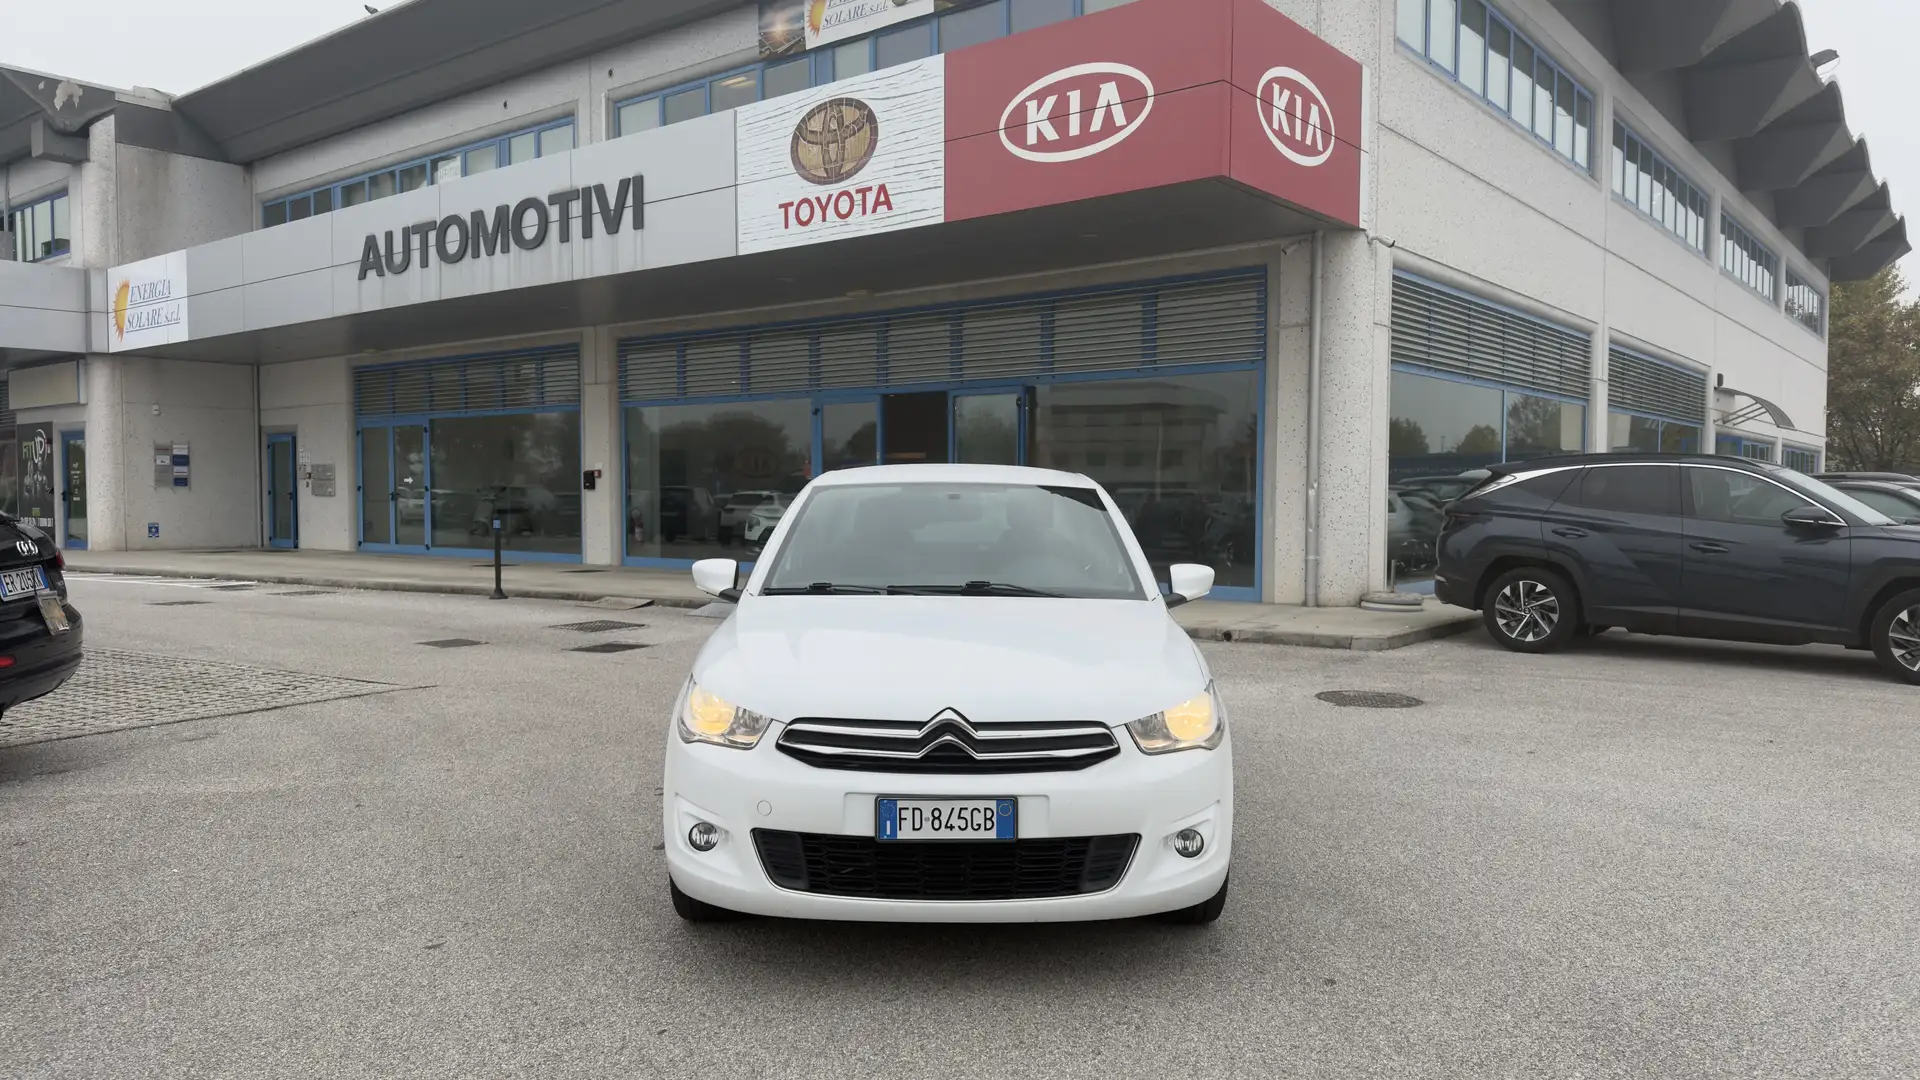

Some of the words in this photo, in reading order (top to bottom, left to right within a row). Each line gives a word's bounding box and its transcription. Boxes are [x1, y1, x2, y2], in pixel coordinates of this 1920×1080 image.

[822, 3, 868, 28] SOLARE
[1025, 80, 1128, 146] KIA
[1272, 82, 1324, 152] KIA
[358, 174, 644, 280] AUTOMOTIVI
[778, 183, 894, 230] TOYOTA
[130, 279, 171, 303] ENERGIA
[127, 307, 164, 330] SOLARE
